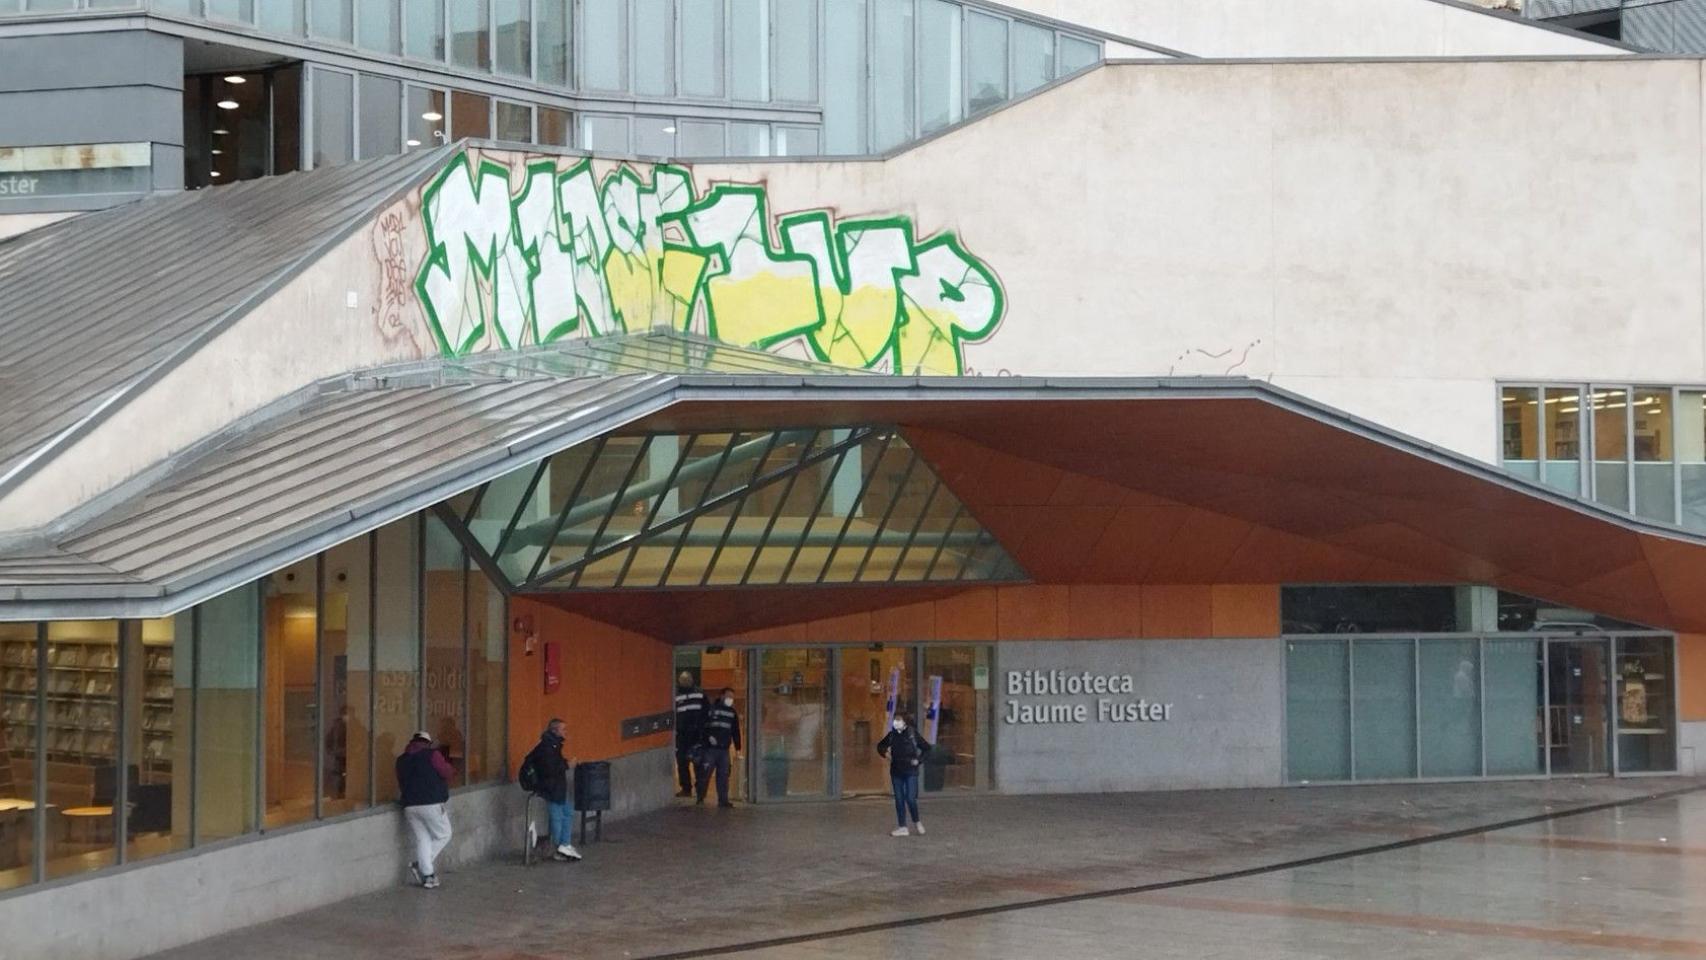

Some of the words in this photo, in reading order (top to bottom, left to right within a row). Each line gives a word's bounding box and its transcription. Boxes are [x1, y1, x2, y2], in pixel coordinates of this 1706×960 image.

[1008, 670, 1133, 694] Biblioteca
[1006, 700, 1087, 723] Jaume
[1099, 699, 1173, 722] Fuster
